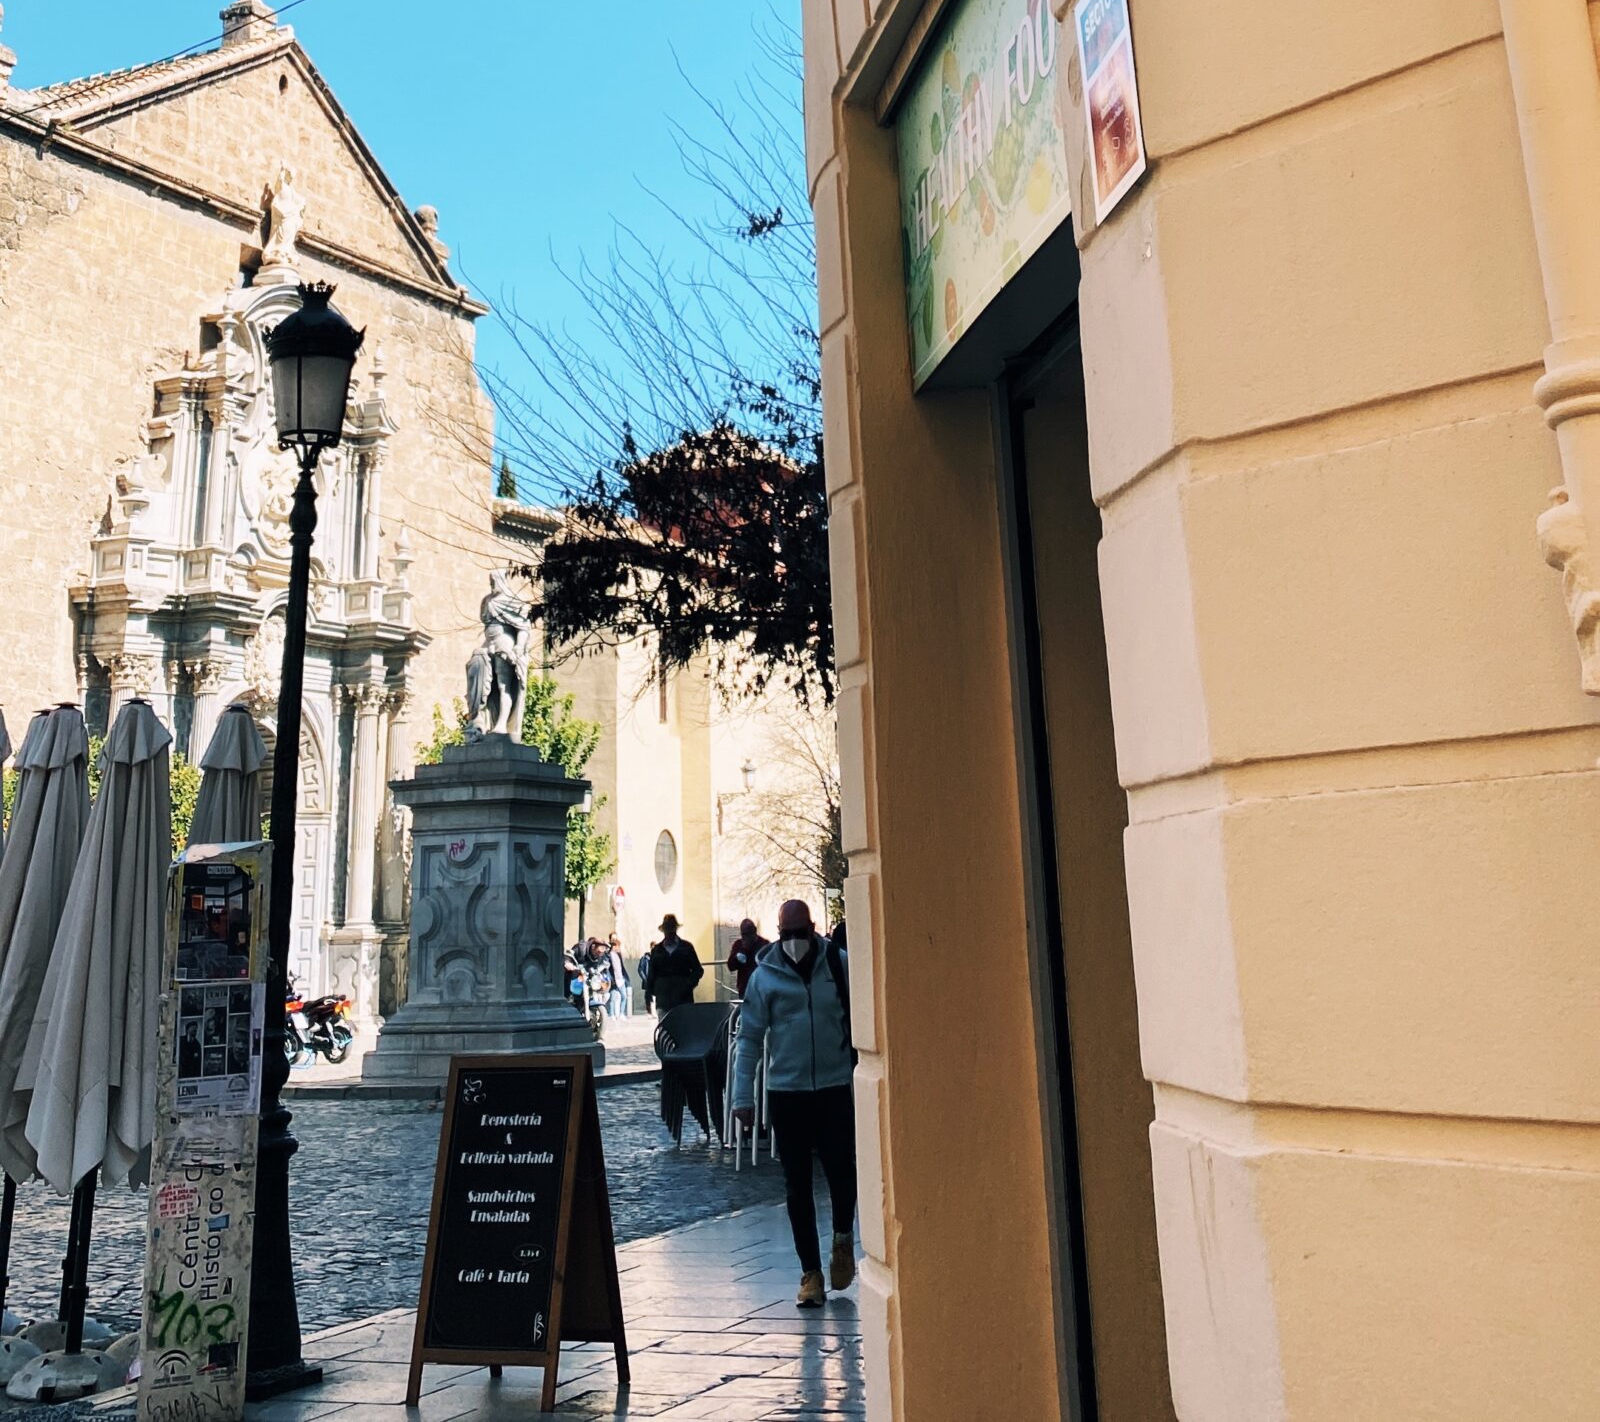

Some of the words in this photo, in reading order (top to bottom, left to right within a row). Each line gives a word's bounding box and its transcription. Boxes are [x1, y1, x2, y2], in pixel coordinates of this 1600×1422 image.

[914, 66, 994, 261] HEALTHY
[177, 1084, 199, 1098] LENIN
[480, 1112, 542, 1127] Repostería
[504, 1132, 513, 1145] &
[508, 1150, 554, 1165] variada
[467, 1189, 536, 1203] Sandwiches
[470, 1209, 531, 1223] Ensaladas
[458, 1268, 485, 1283] Café
[497, 1269, 530, 1284] Tarta
